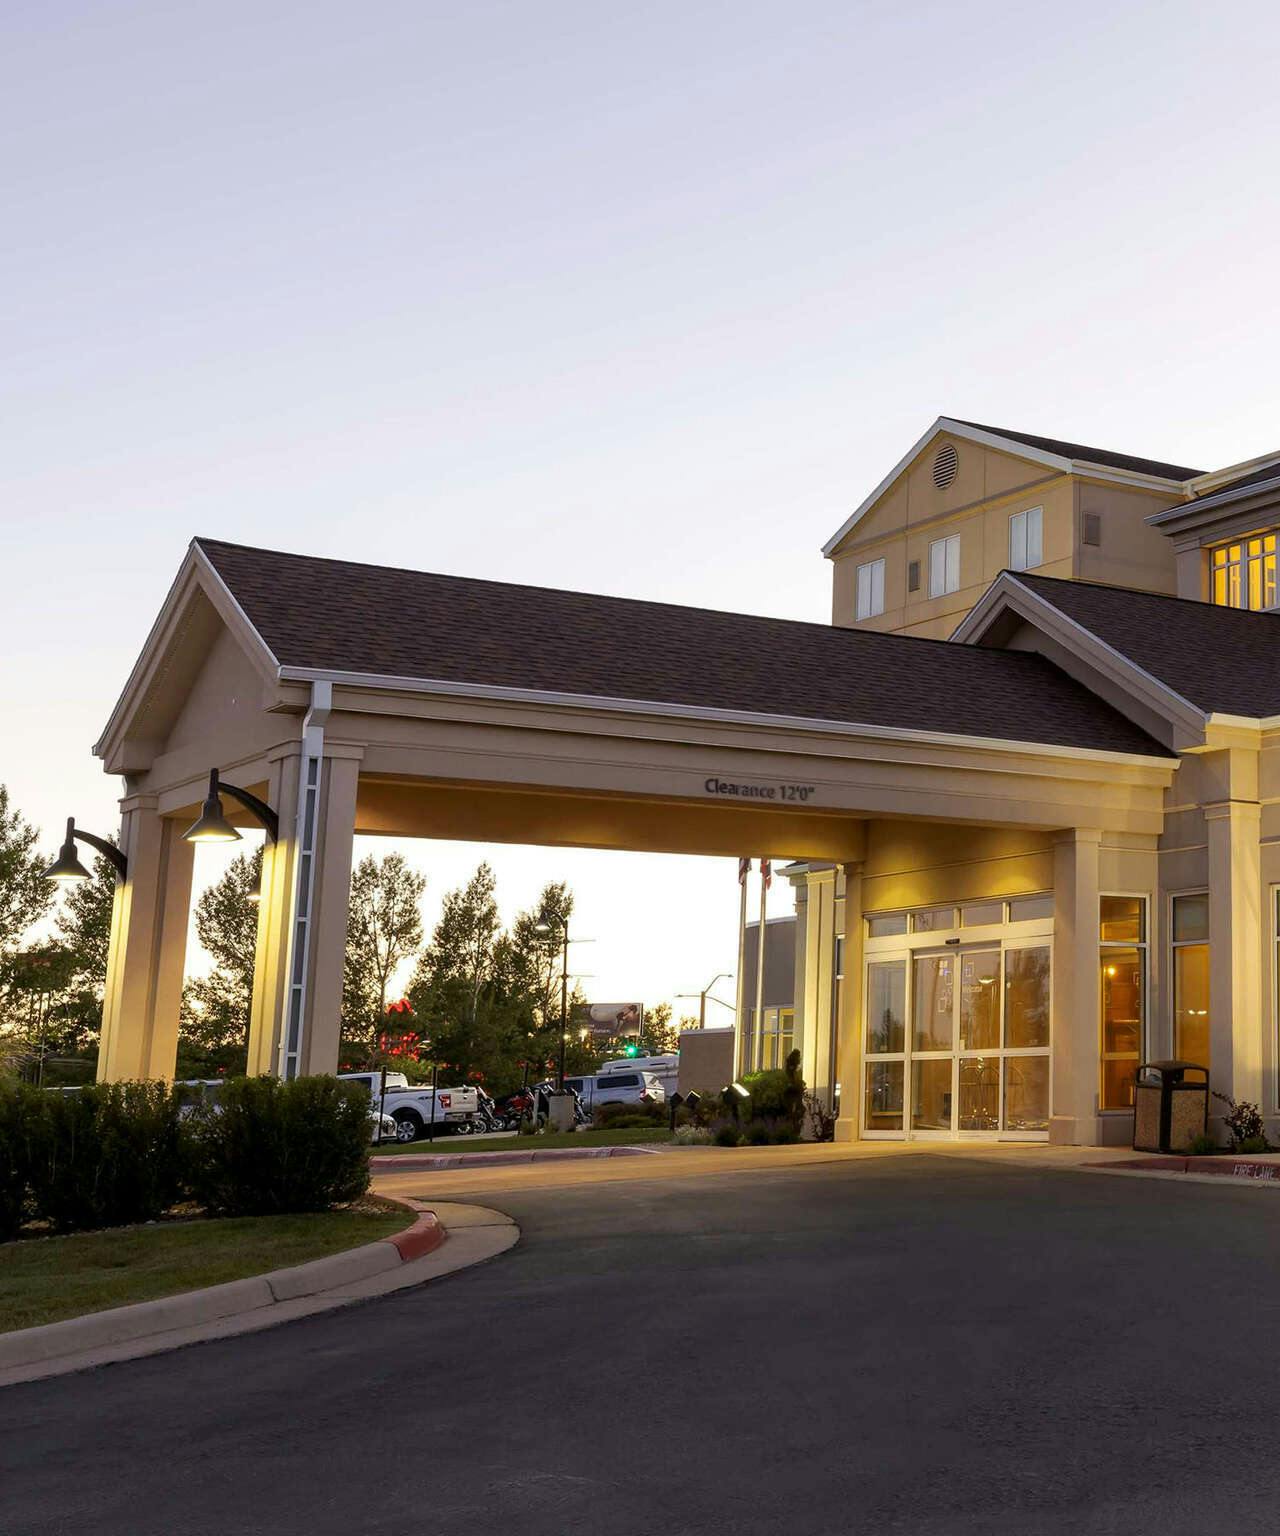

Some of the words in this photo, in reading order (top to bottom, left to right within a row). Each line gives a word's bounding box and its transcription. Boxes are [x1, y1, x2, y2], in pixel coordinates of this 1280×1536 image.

[704, 778, 776, 799] Clearance
[1232, 1164, 1254, 1178] FIRE
[1253, 1165, 1276, 1180] LANE
